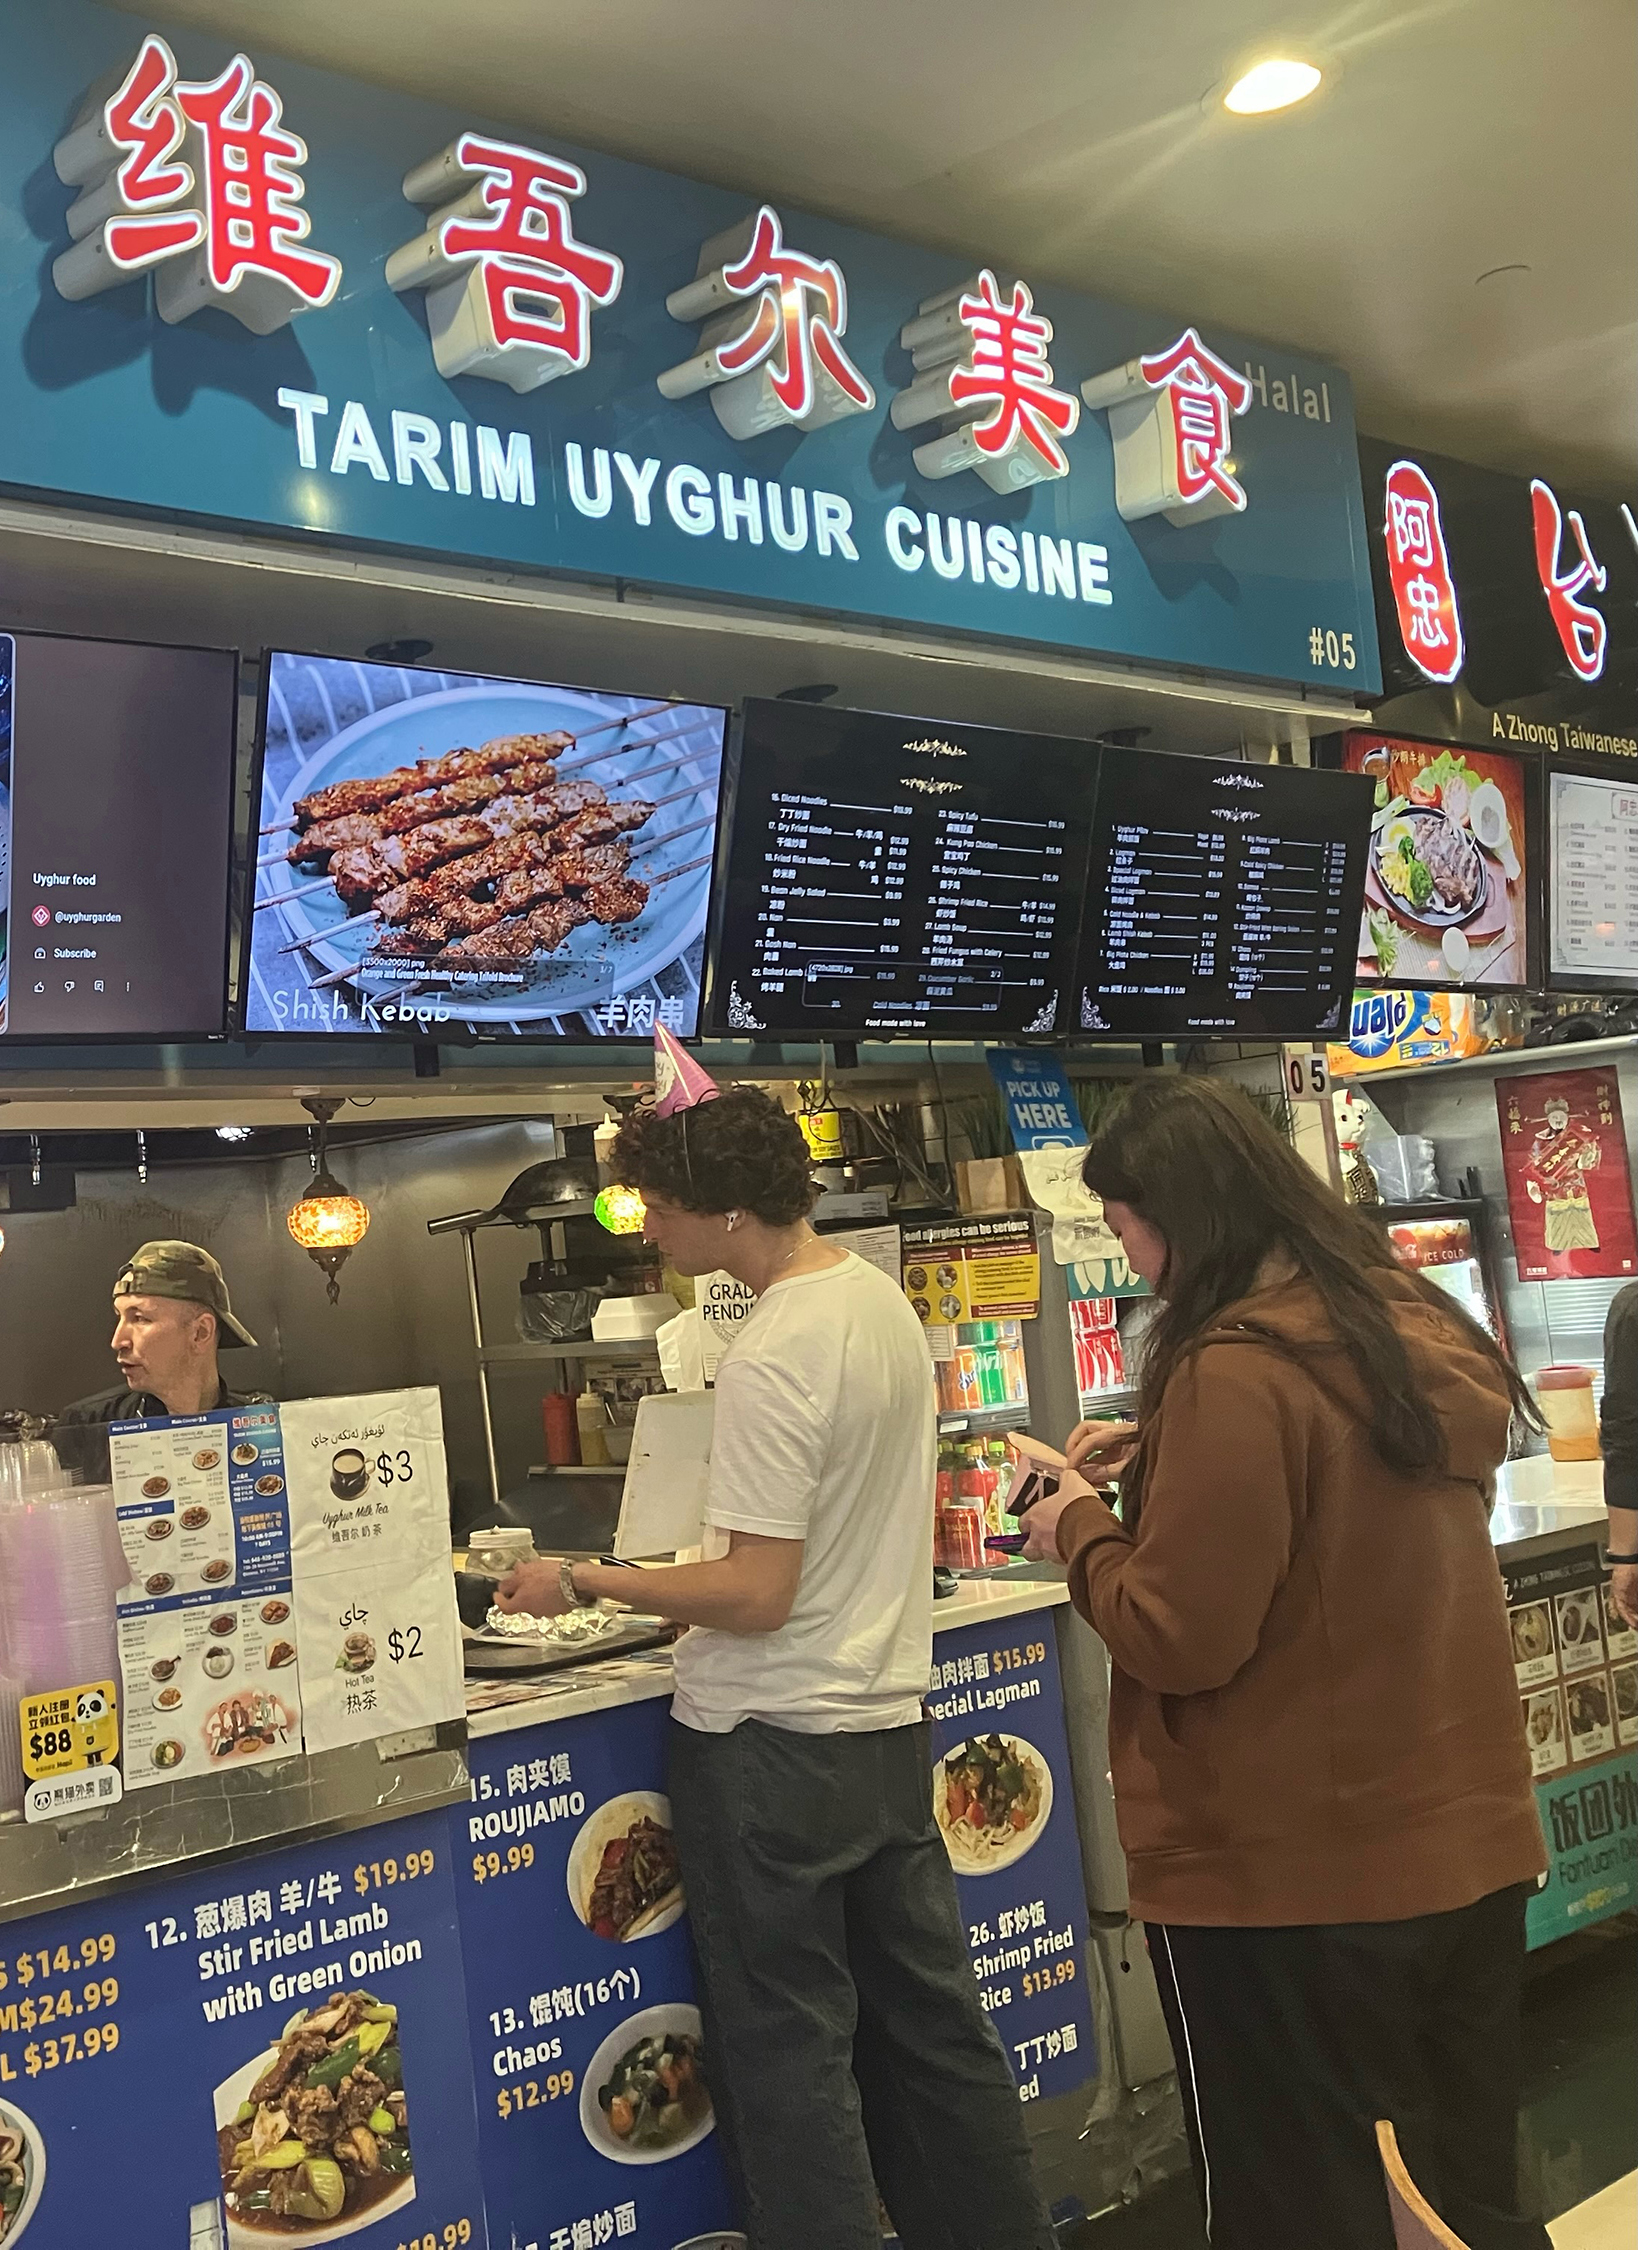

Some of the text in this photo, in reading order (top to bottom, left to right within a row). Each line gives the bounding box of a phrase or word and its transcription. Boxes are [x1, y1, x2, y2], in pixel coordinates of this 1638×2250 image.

[105, 34, 1253, 513] 维吾尔美食
[1245, 361, 1331, 423] Halal
[277, 387, 1114, 606] TARIM UYGHUR CUISINE
[1389, 491, 1449, 647] 阿忠
[1309, 627, 1356, 670] #05
[1493, 712, 1638, 757] A Zhong Taiwanese
[33, 872, 96, 888] Uyghur food
[55, 910, 122, 924] @uyghurgarden
[54, 948, 96, 960] Subscribe
[362, 968, 382, 979] Orange
[384, 970, 396, 978] and
[396, 970, 414, 980] Green
[414, 971, 430, 980] Fresh
[454, 972, 478, 982] Catering
[272, 989, 451, 1023] Shish Kebab
[596, 994, 684, 1029] 羊肉串
[865, 1018, 880, 1027] Food
[881, 1019, 898, 1027] made
[899, 1019, 912, 1027] with
[1006, 1081, 1060, 1098] PICK UP
[1014, 1104, 1072, 1128] HERE
[922, 1227, 960, 1243] allergies
[962, 1225, 978, 1236] can
[979, 1224, 992, 1234] be
[993, 1220, 1030, 1232] serious
[1424, 1249, 1464, 1262] ICE COLD
[703, 1304, 755, 1320] PENDI
[377, 1450, 413, 1488] $3
[322, 1502, 389, 1530] Uyghur Milk Tea
[340, 1602, 369, 1630] چاي
[388, 1626, 424, 1664] $2
[992, 1642, 1046, 1675] $15.99
[345, 1674, 374, 1688] Hot Tea
[928, 1679, 1040, 1720] ecial Lagman
[346, 1690, 378, 1715] 热茶
[30, 1729, 72, 1761] $88
[507, 1752, 572, 1798] 肉夹馍
[468, 1791, 586, 1842] ROUJIAMO
[472, 1843, 536, 1884] $9.99
[145, 1849, 436, 1950] 12. 葱爆肉 羊/牛 $19.99
[198, 1902, 389, 1980] Stir Fried Lamb
[969, 1900, 1046, 1948] 26. 虾炒饭
[16, 1934, 116, 1989] $14.99
[973, 1924, 1074, 1980] Shrimp Fried
[202, 1939, 422, 2022] with Green Onion
[1022, 1959, 1076, 1998] $13.99
[489, 2010, 524, 2038] 13.
[0, 2022, 120, 2082] L $37.99
[493, 2036, 563, 2077] Chaos
[1014, 2024, 1078, 2072] 丁丁炒面
[496, 2070, 575, 2120] $12.99
[1019, 2074, 1040, 2102] ed
